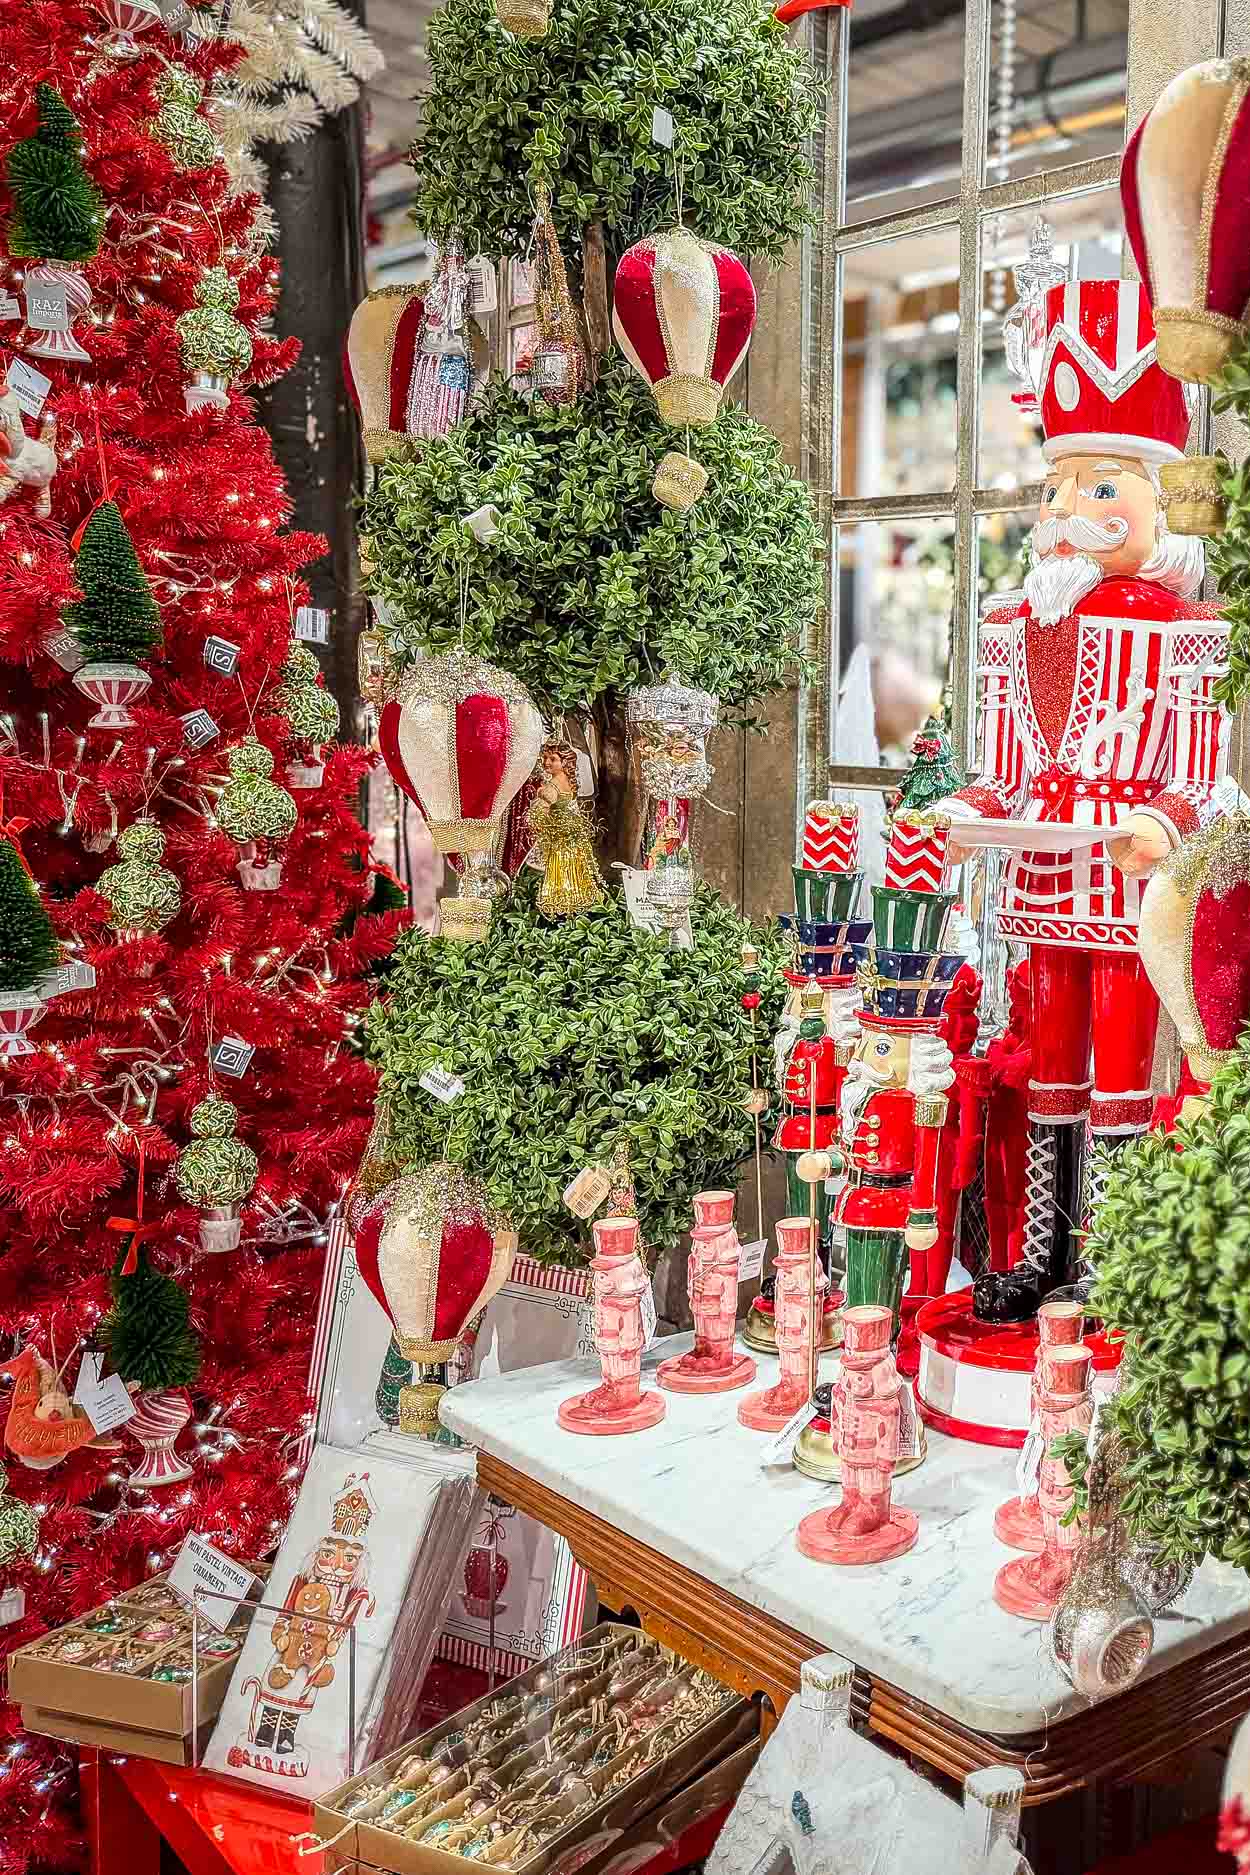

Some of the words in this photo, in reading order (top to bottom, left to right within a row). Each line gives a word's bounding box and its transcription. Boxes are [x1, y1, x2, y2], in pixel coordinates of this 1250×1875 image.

[32, 298, 62, 312] RAZ
[57, 967, 69, 990] RAZ
[187, 1540, 203, 1559] MINI
[200, 1549, 221, 1571] PASTEL
[221, 1563, 247, 1588] VINTAGE
[192, 1562, 227, 1593] ORNAMENTS
